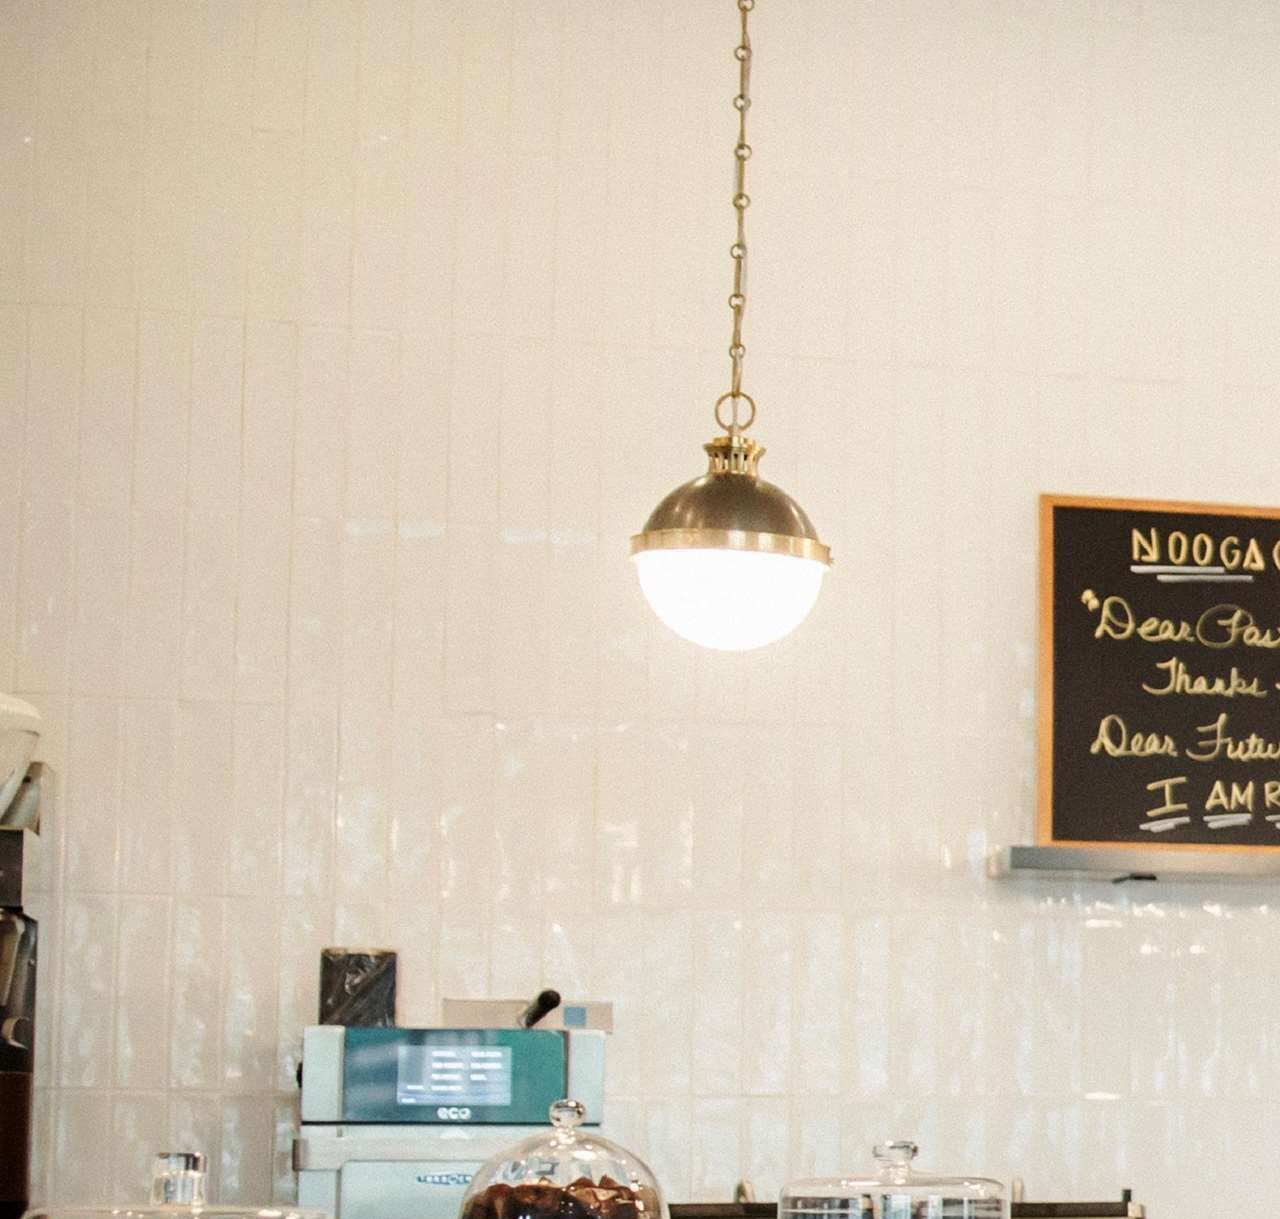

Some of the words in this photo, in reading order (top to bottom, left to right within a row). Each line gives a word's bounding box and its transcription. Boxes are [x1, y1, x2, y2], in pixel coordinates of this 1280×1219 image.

[1142, 657, 1267, 697] Thanks
[1090, 714, 1179, 757] Dear
[1146, 776, 1190, 817] I
[1204, 780, 1254, 812] AM
[437, 1107, 471, 1120] eco
